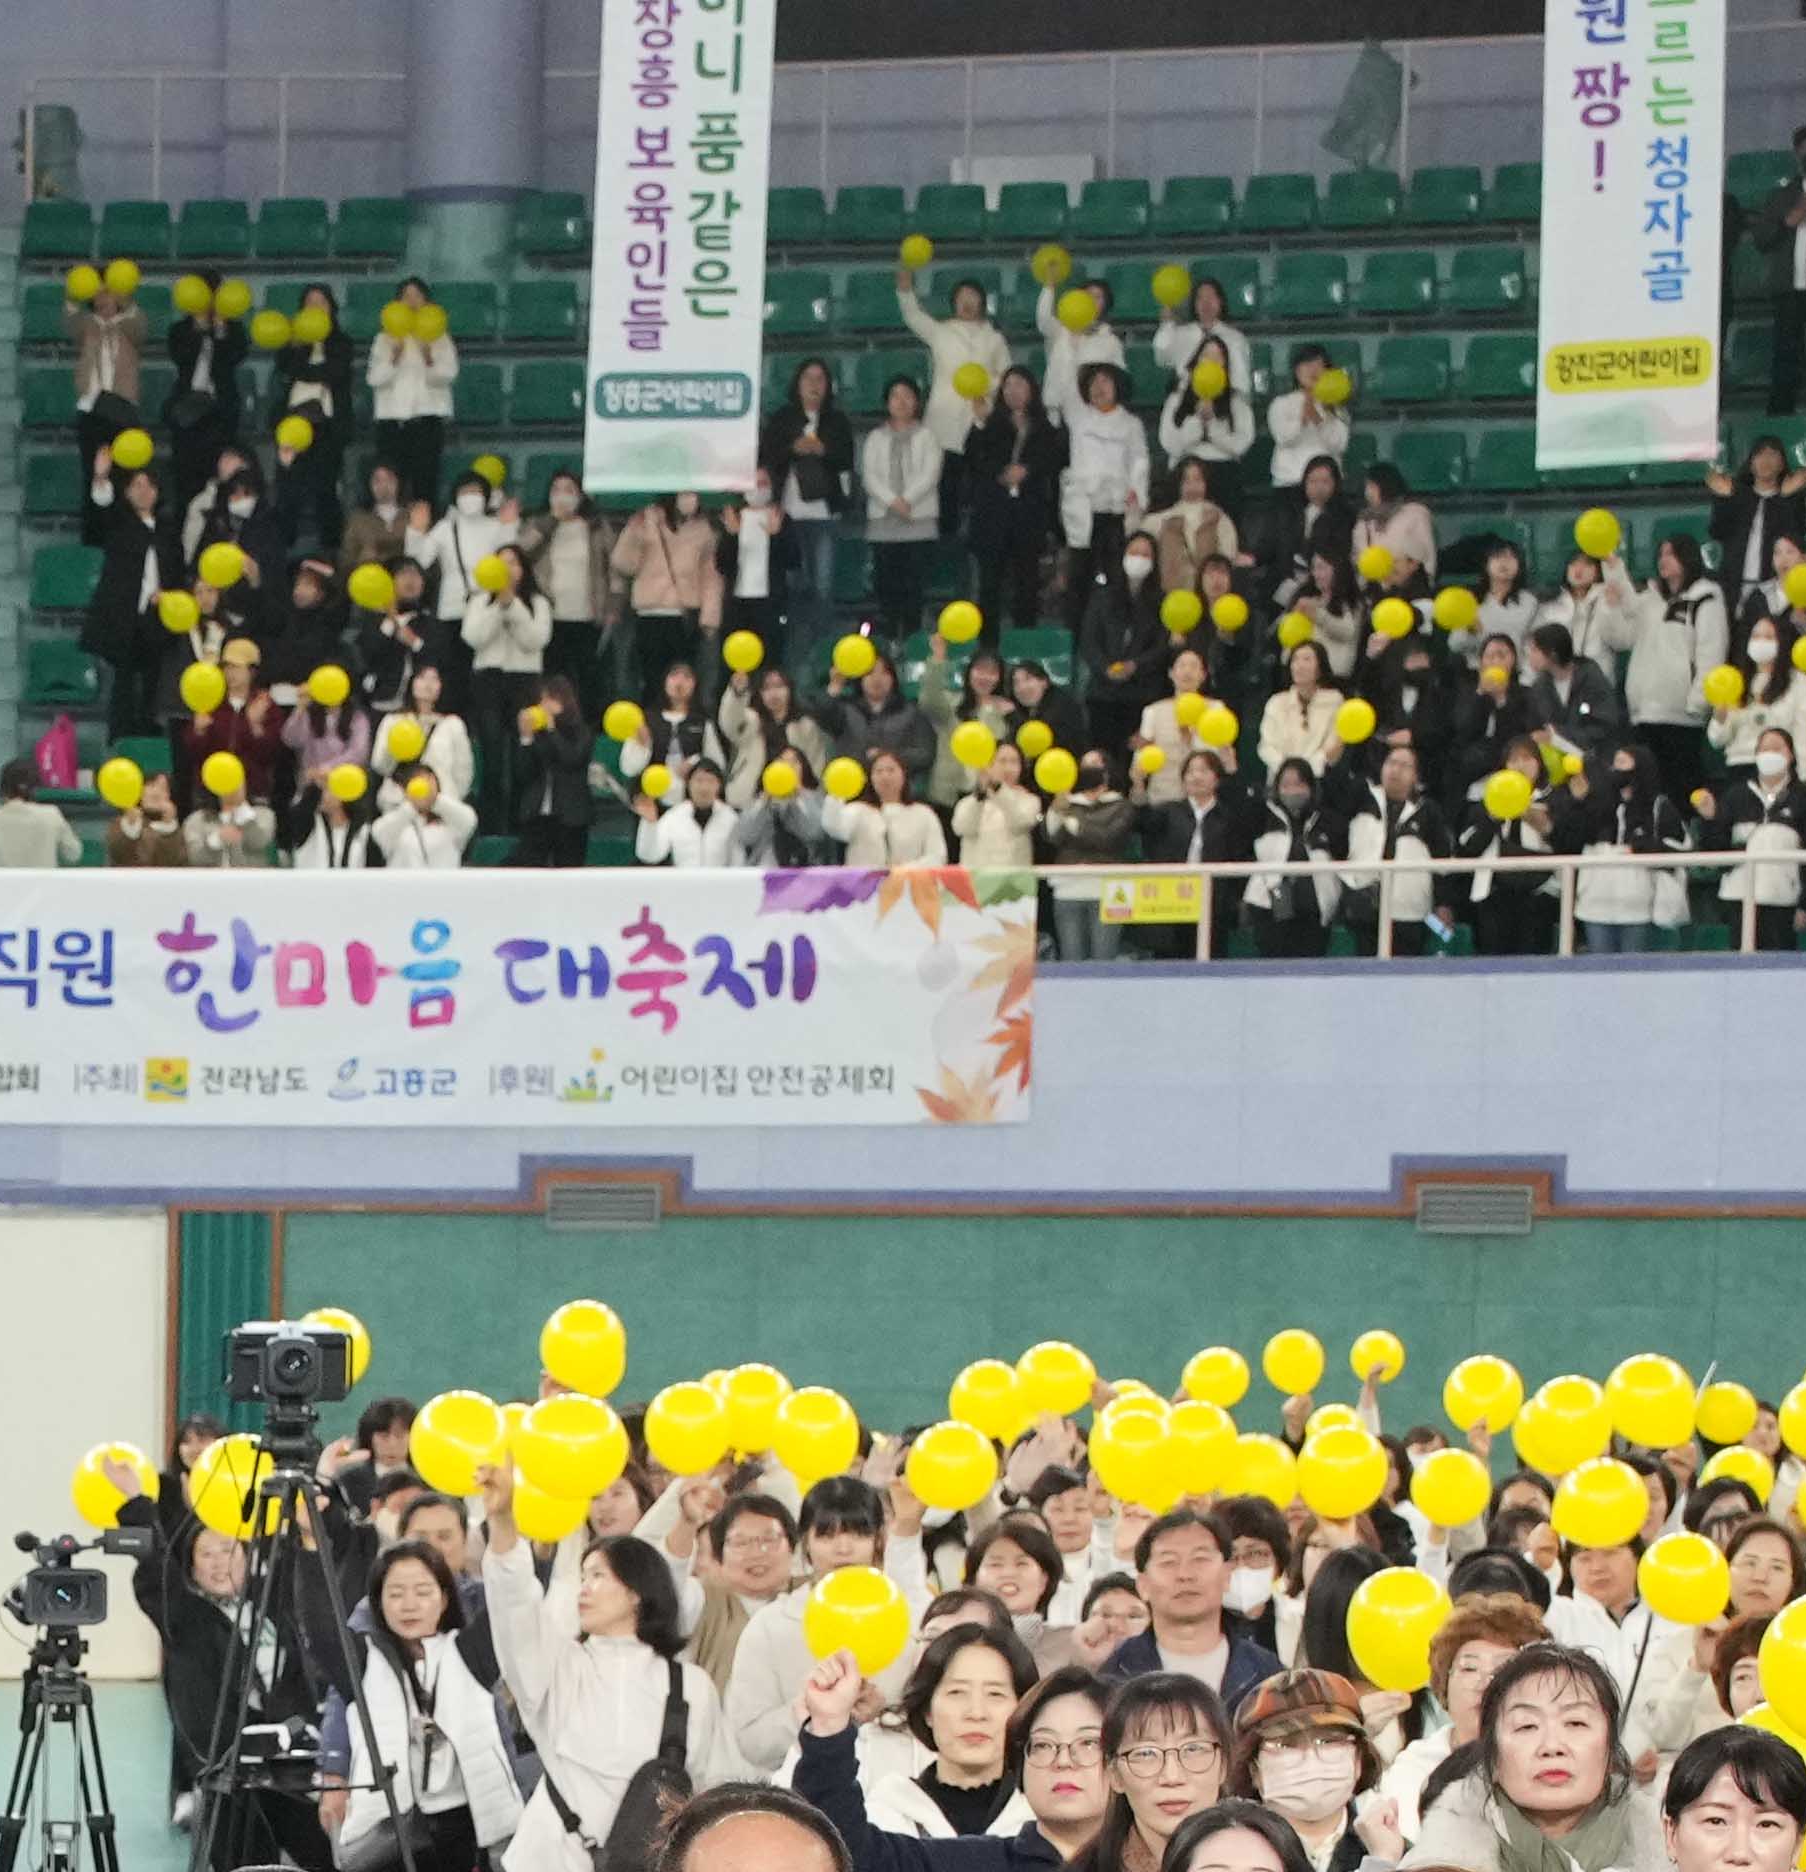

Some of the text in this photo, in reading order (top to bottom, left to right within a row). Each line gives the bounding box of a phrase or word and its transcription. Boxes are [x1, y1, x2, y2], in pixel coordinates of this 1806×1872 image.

[1572, 62, 1630, 192] 짱!
[622, 126, 674, 351] 보육인들
[1555, 346, 1700, 384] 강진군어린이집
[602, 380, 744, 415] 장흥군어린이집
[156, 911, 463, 1034] 한마음
[493, 904, 819, 1035] 대축제
[200, 1065, 310, 1095] 전라남도
[620, 1062, 738, 1098] 어린이집
[746, 1062, 896, 1099] 안전공제회
